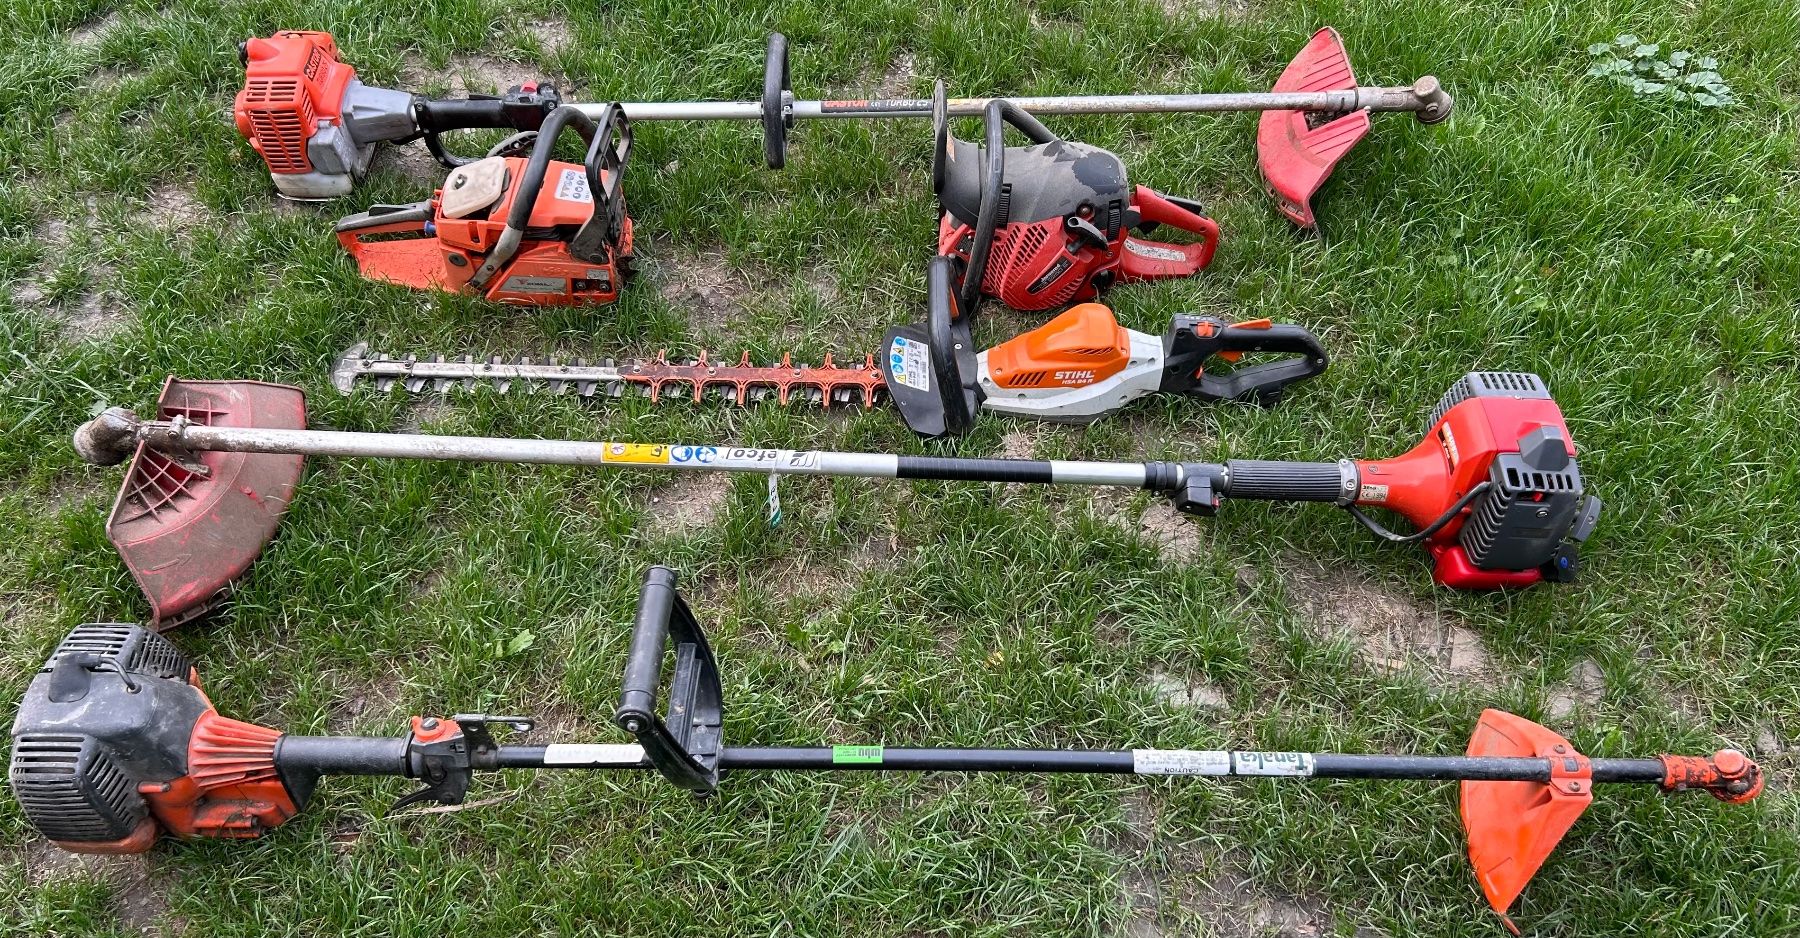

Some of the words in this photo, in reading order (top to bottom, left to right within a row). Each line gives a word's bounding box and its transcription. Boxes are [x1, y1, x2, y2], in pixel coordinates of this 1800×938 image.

[823, 99, 868, 108] CASTOR
[885, 99, 915, 107] TURBO
[1054, 370, 1095, 379] STIHL
[733, 449, 777, 461] efco
[1240, 752, 1308, 771] Tanaka
